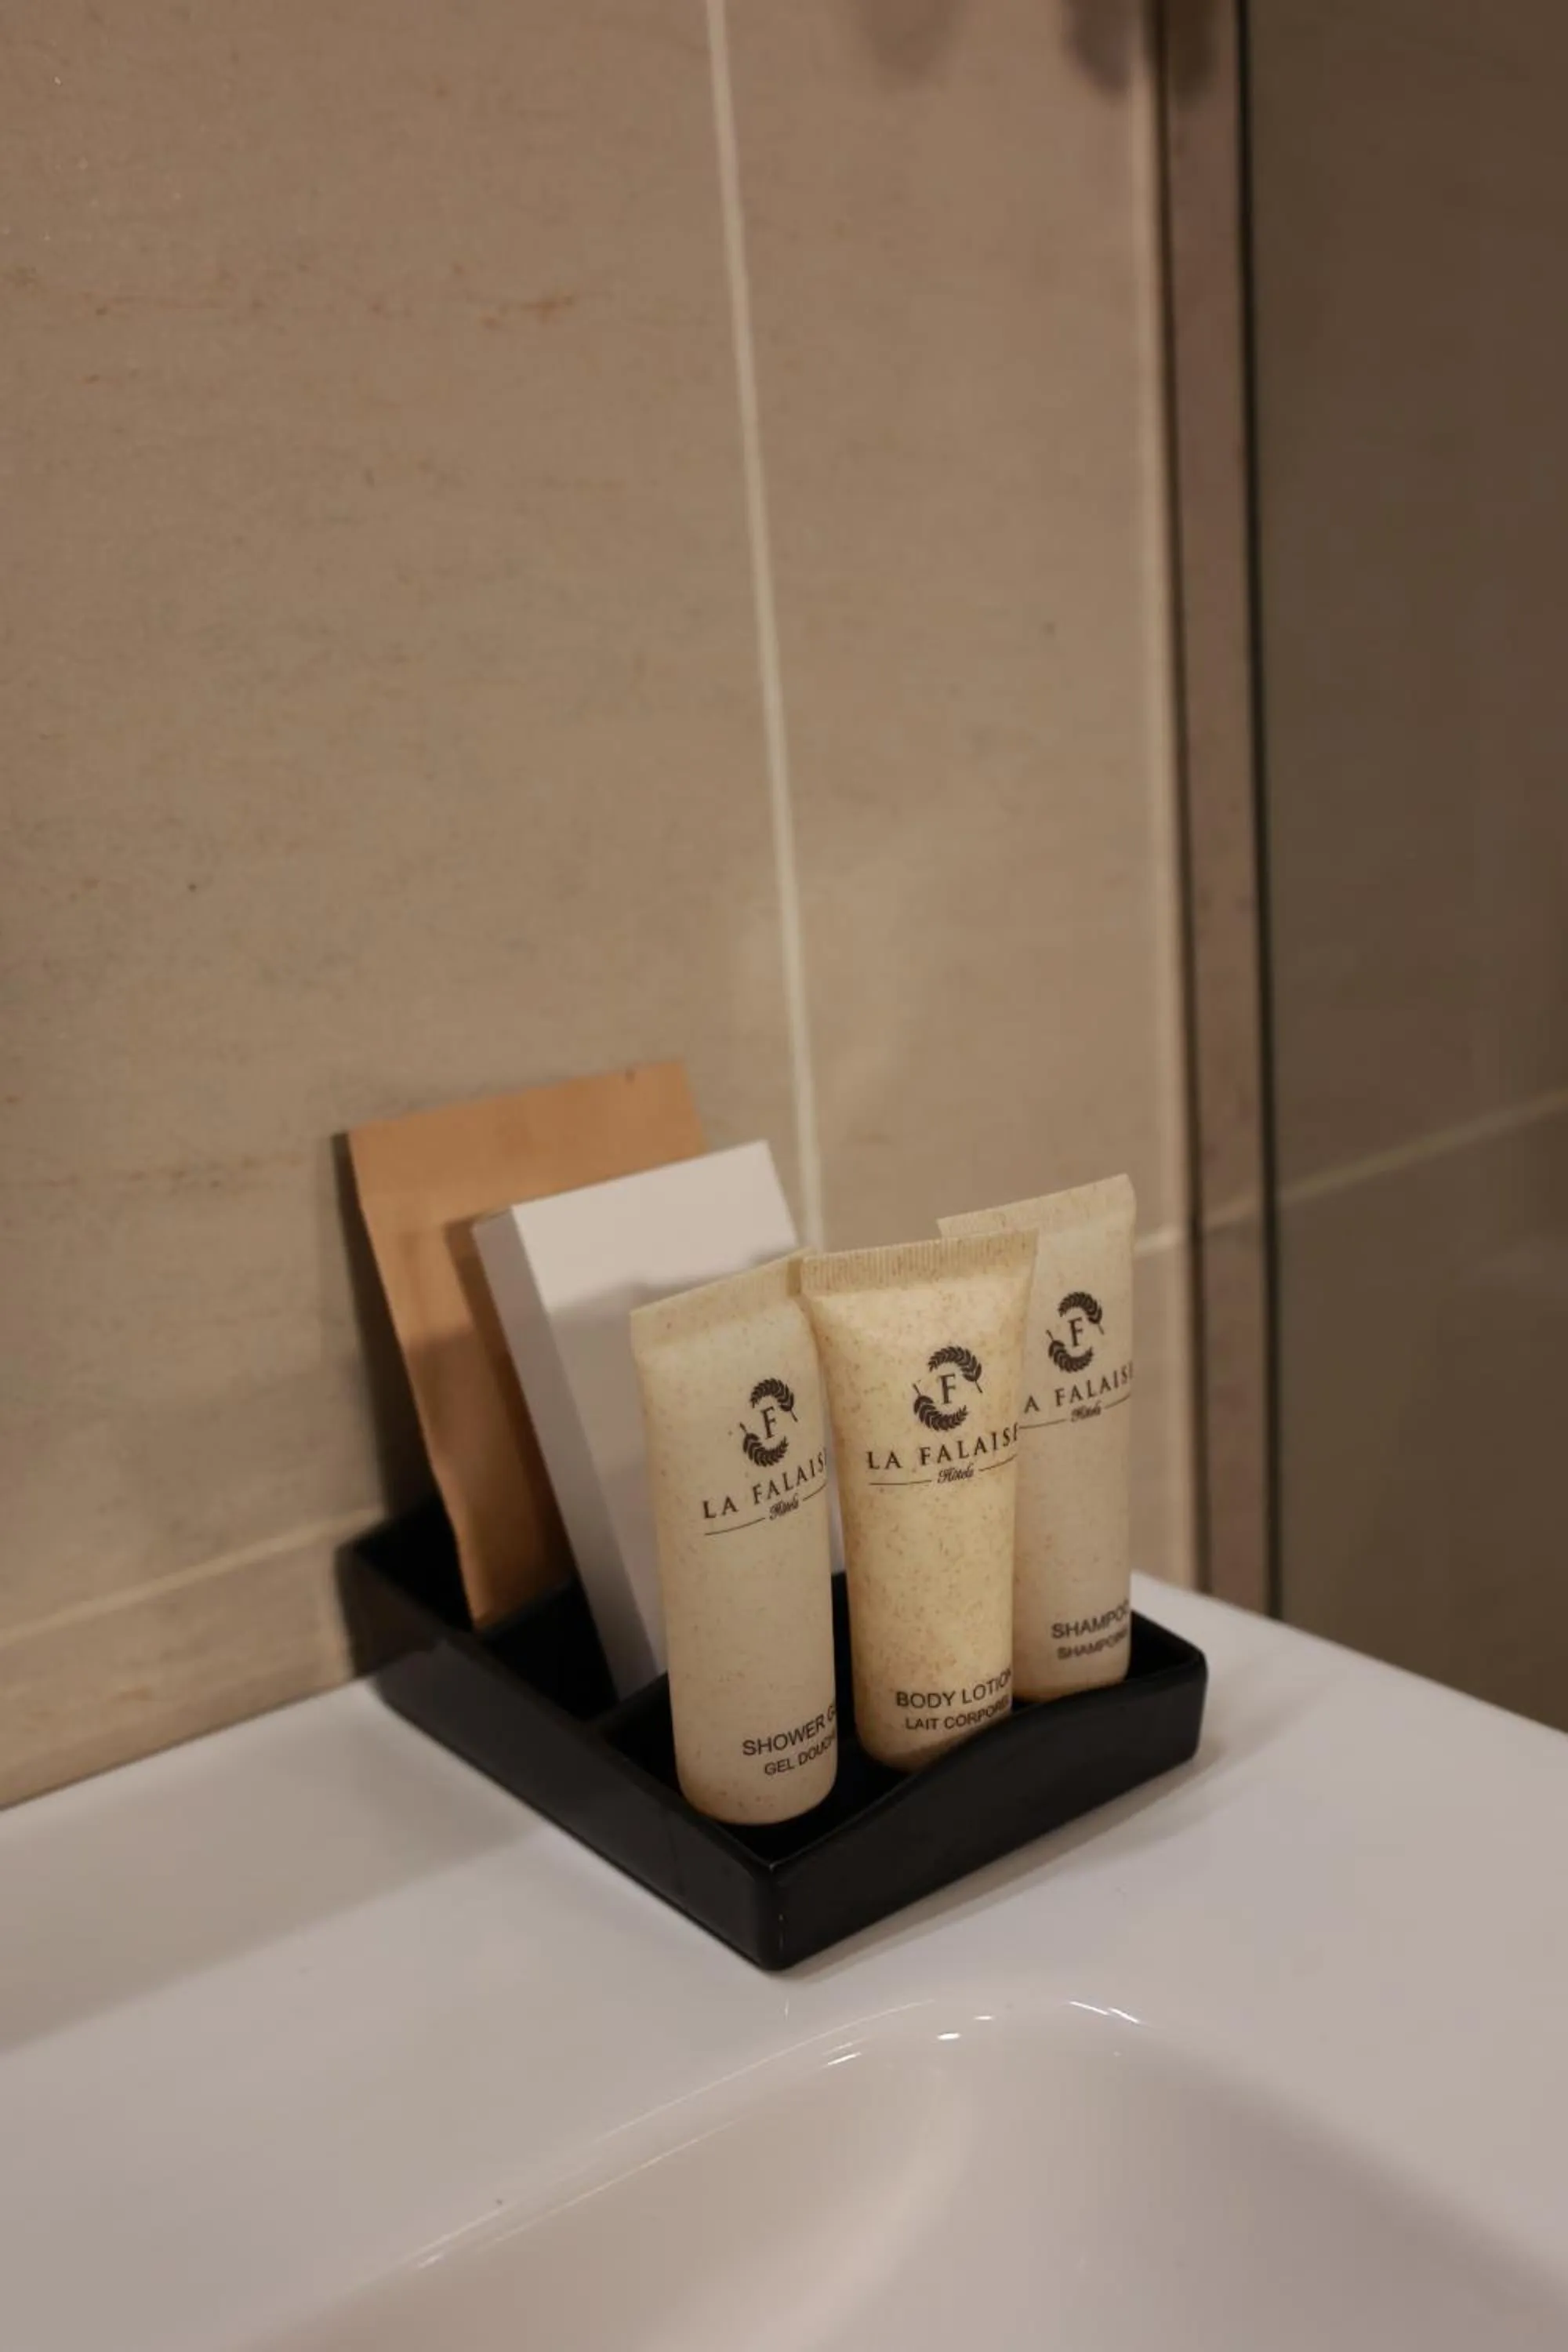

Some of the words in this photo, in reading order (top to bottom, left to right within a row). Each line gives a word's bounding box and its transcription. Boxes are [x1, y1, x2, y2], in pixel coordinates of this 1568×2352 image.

[1068, 1317, 1083, 1347] F
[938, 1373, 956, 1404] F
[1024, 1395, 1040, 1414] A
[760, 1406, 777, 1440] F
[866, 1450, 903, 1470] LA
[702, 1497, 739, 1519] LA
[752, 1447, 827, 1505] FALAIS
[896, 1690, 956, 1709] BODY
[742, 1713, 826, 1756] SHOWER
[905, 1717, 939, 1731] LAIT
[764, 1758, 795, 1777] GEL
